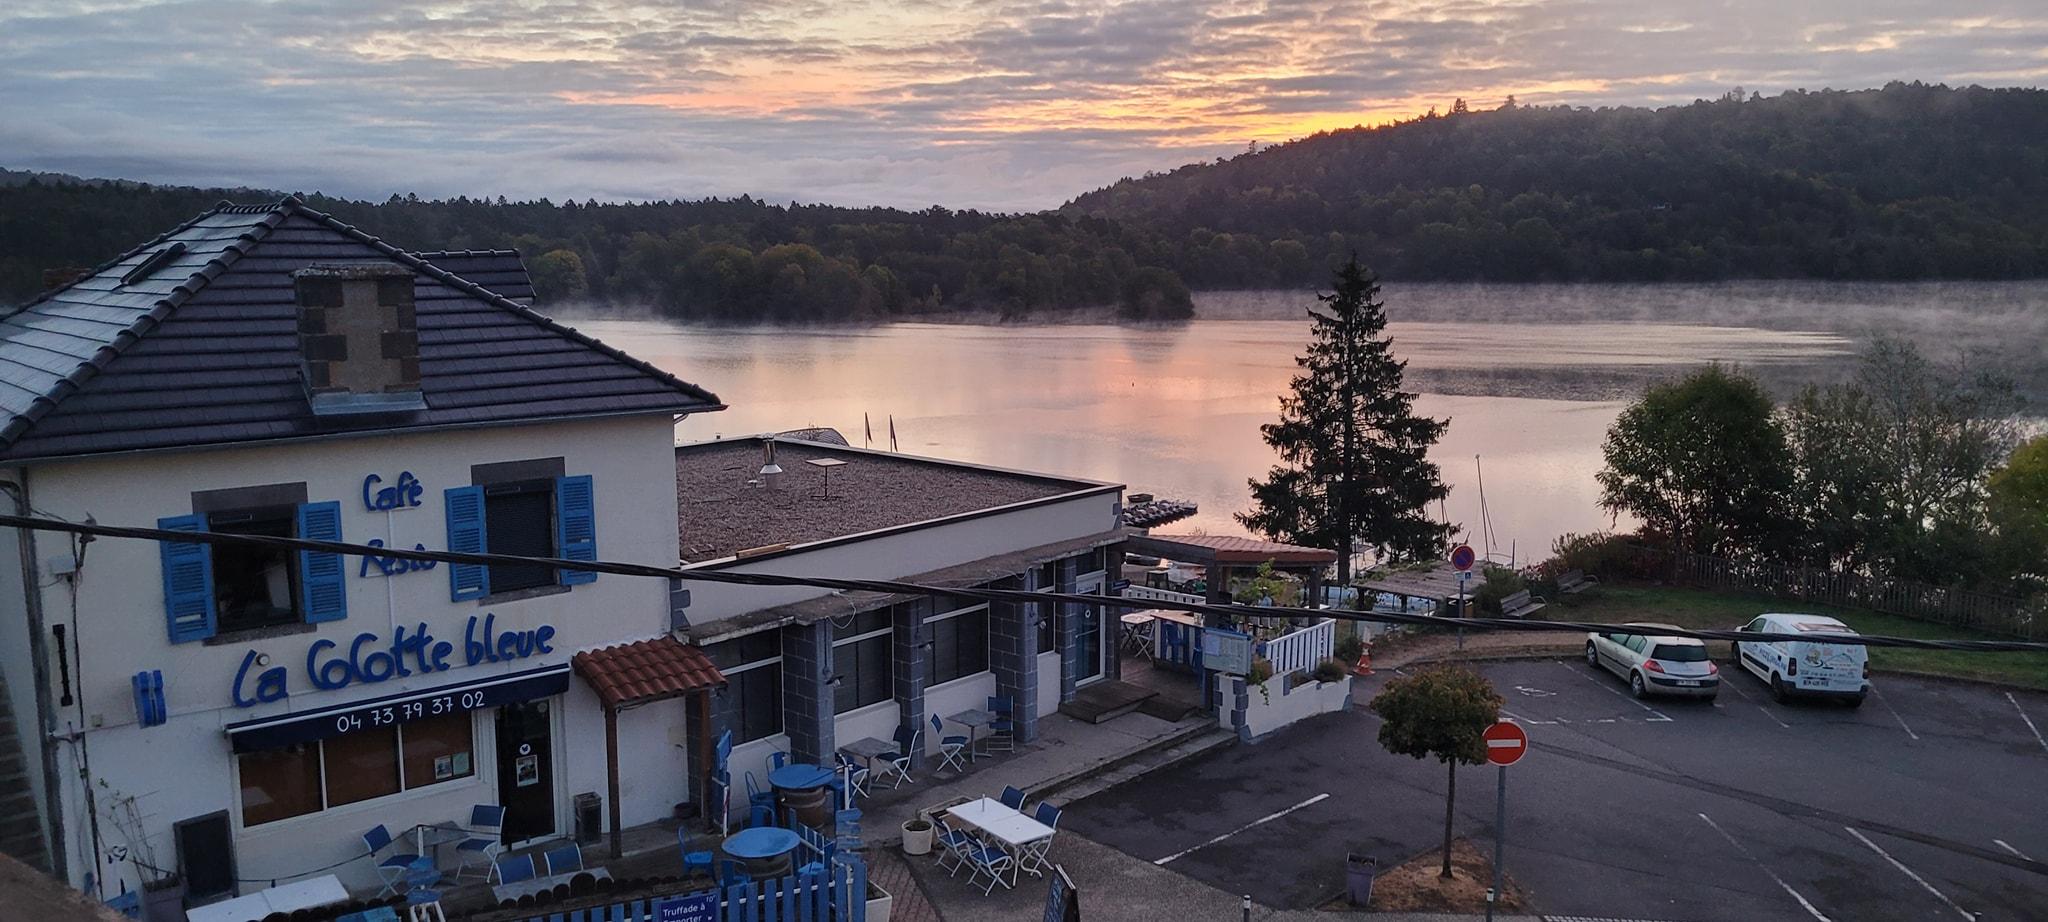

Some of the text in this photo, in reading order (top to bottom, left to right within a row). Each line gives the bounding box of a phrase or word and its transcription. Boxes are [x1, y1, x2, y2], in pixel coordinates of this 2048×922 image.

[363, 471, 423, 511] Café
[232, 649, 288, 708] La
[465, 613, 555, 667] bleue
[337, 691, 485, 732] 04 73 79 37 02
[663, 904, 698, 917] Truffade
